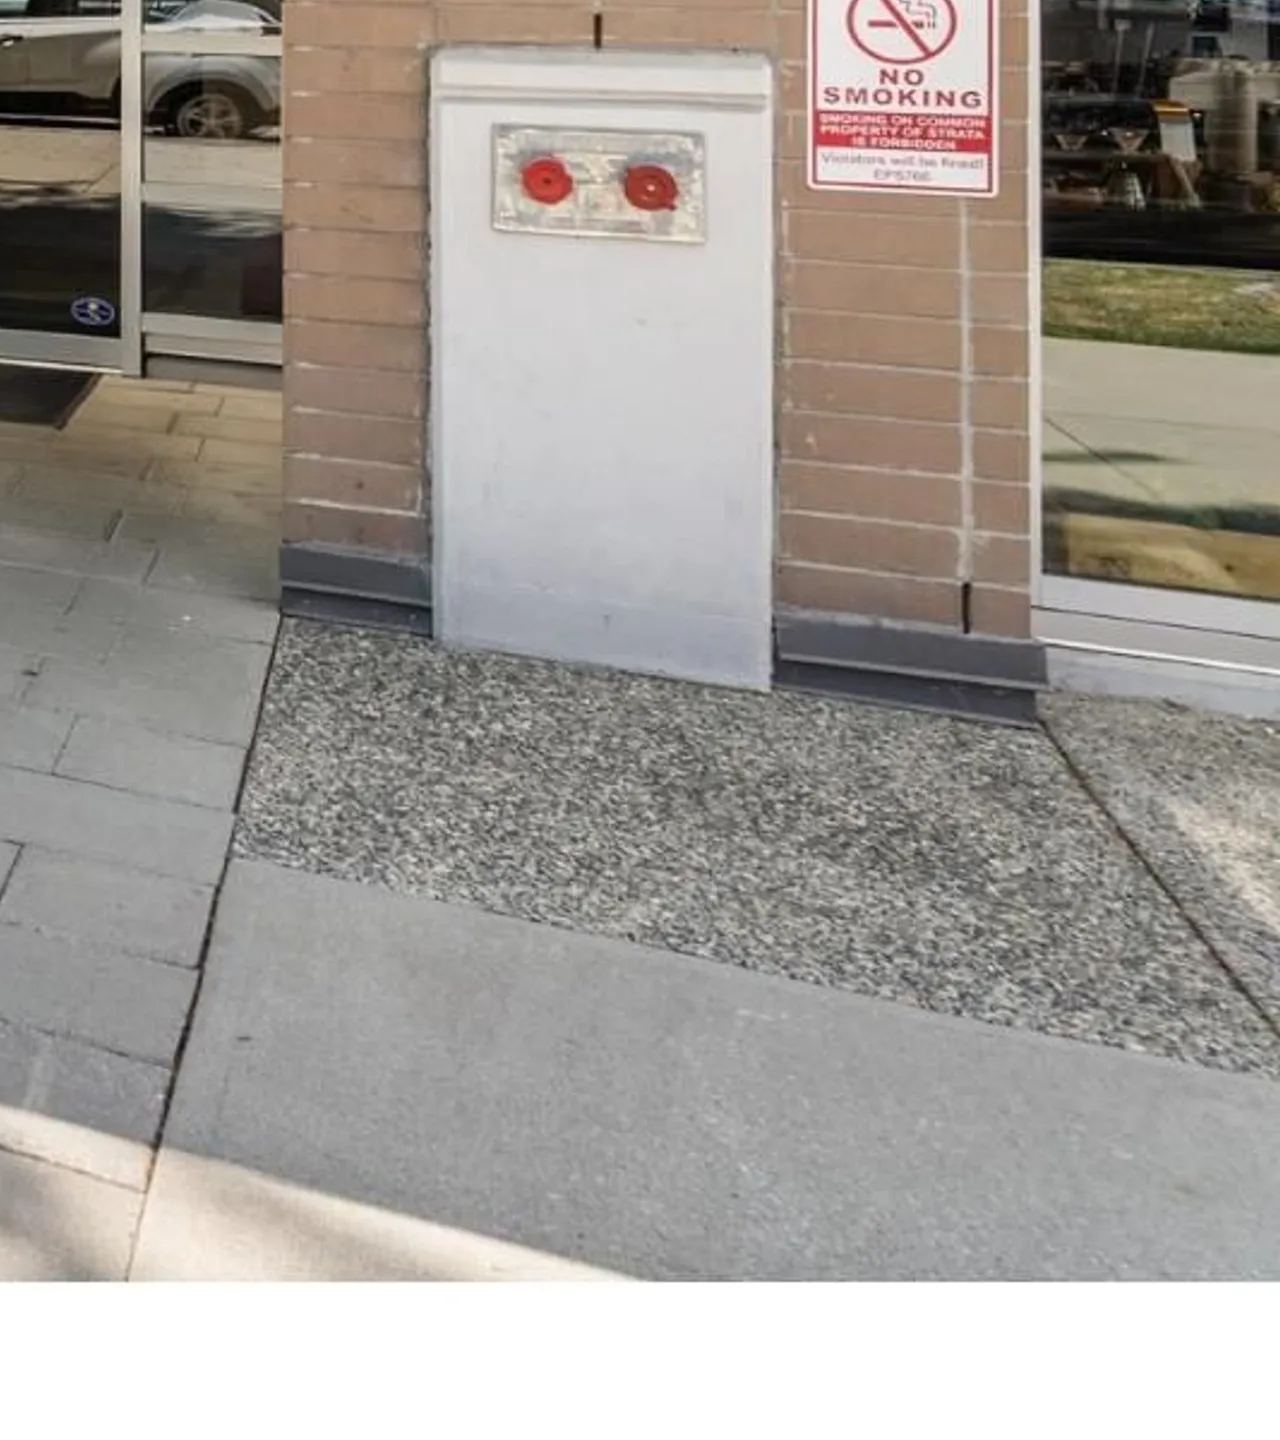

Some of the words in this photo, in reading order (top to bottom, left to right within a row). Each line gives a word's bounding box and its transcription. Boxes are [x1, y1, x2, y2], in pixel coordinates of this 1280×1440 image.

[878, 68, 925, 86] NO
[823, 86, 982, 109] SMOKING
[819, 113, 888, 126] SMOKING
[890, 115, 913, 127] ON
[917, 116, 987, 129] COMMON
[819, 125, 899, 139] PROPERTY
[902, 127, 923, 139] OF
[926, 128, 985, 140] STRATA
[869, 137, 957, 150] FORBIDDEN
